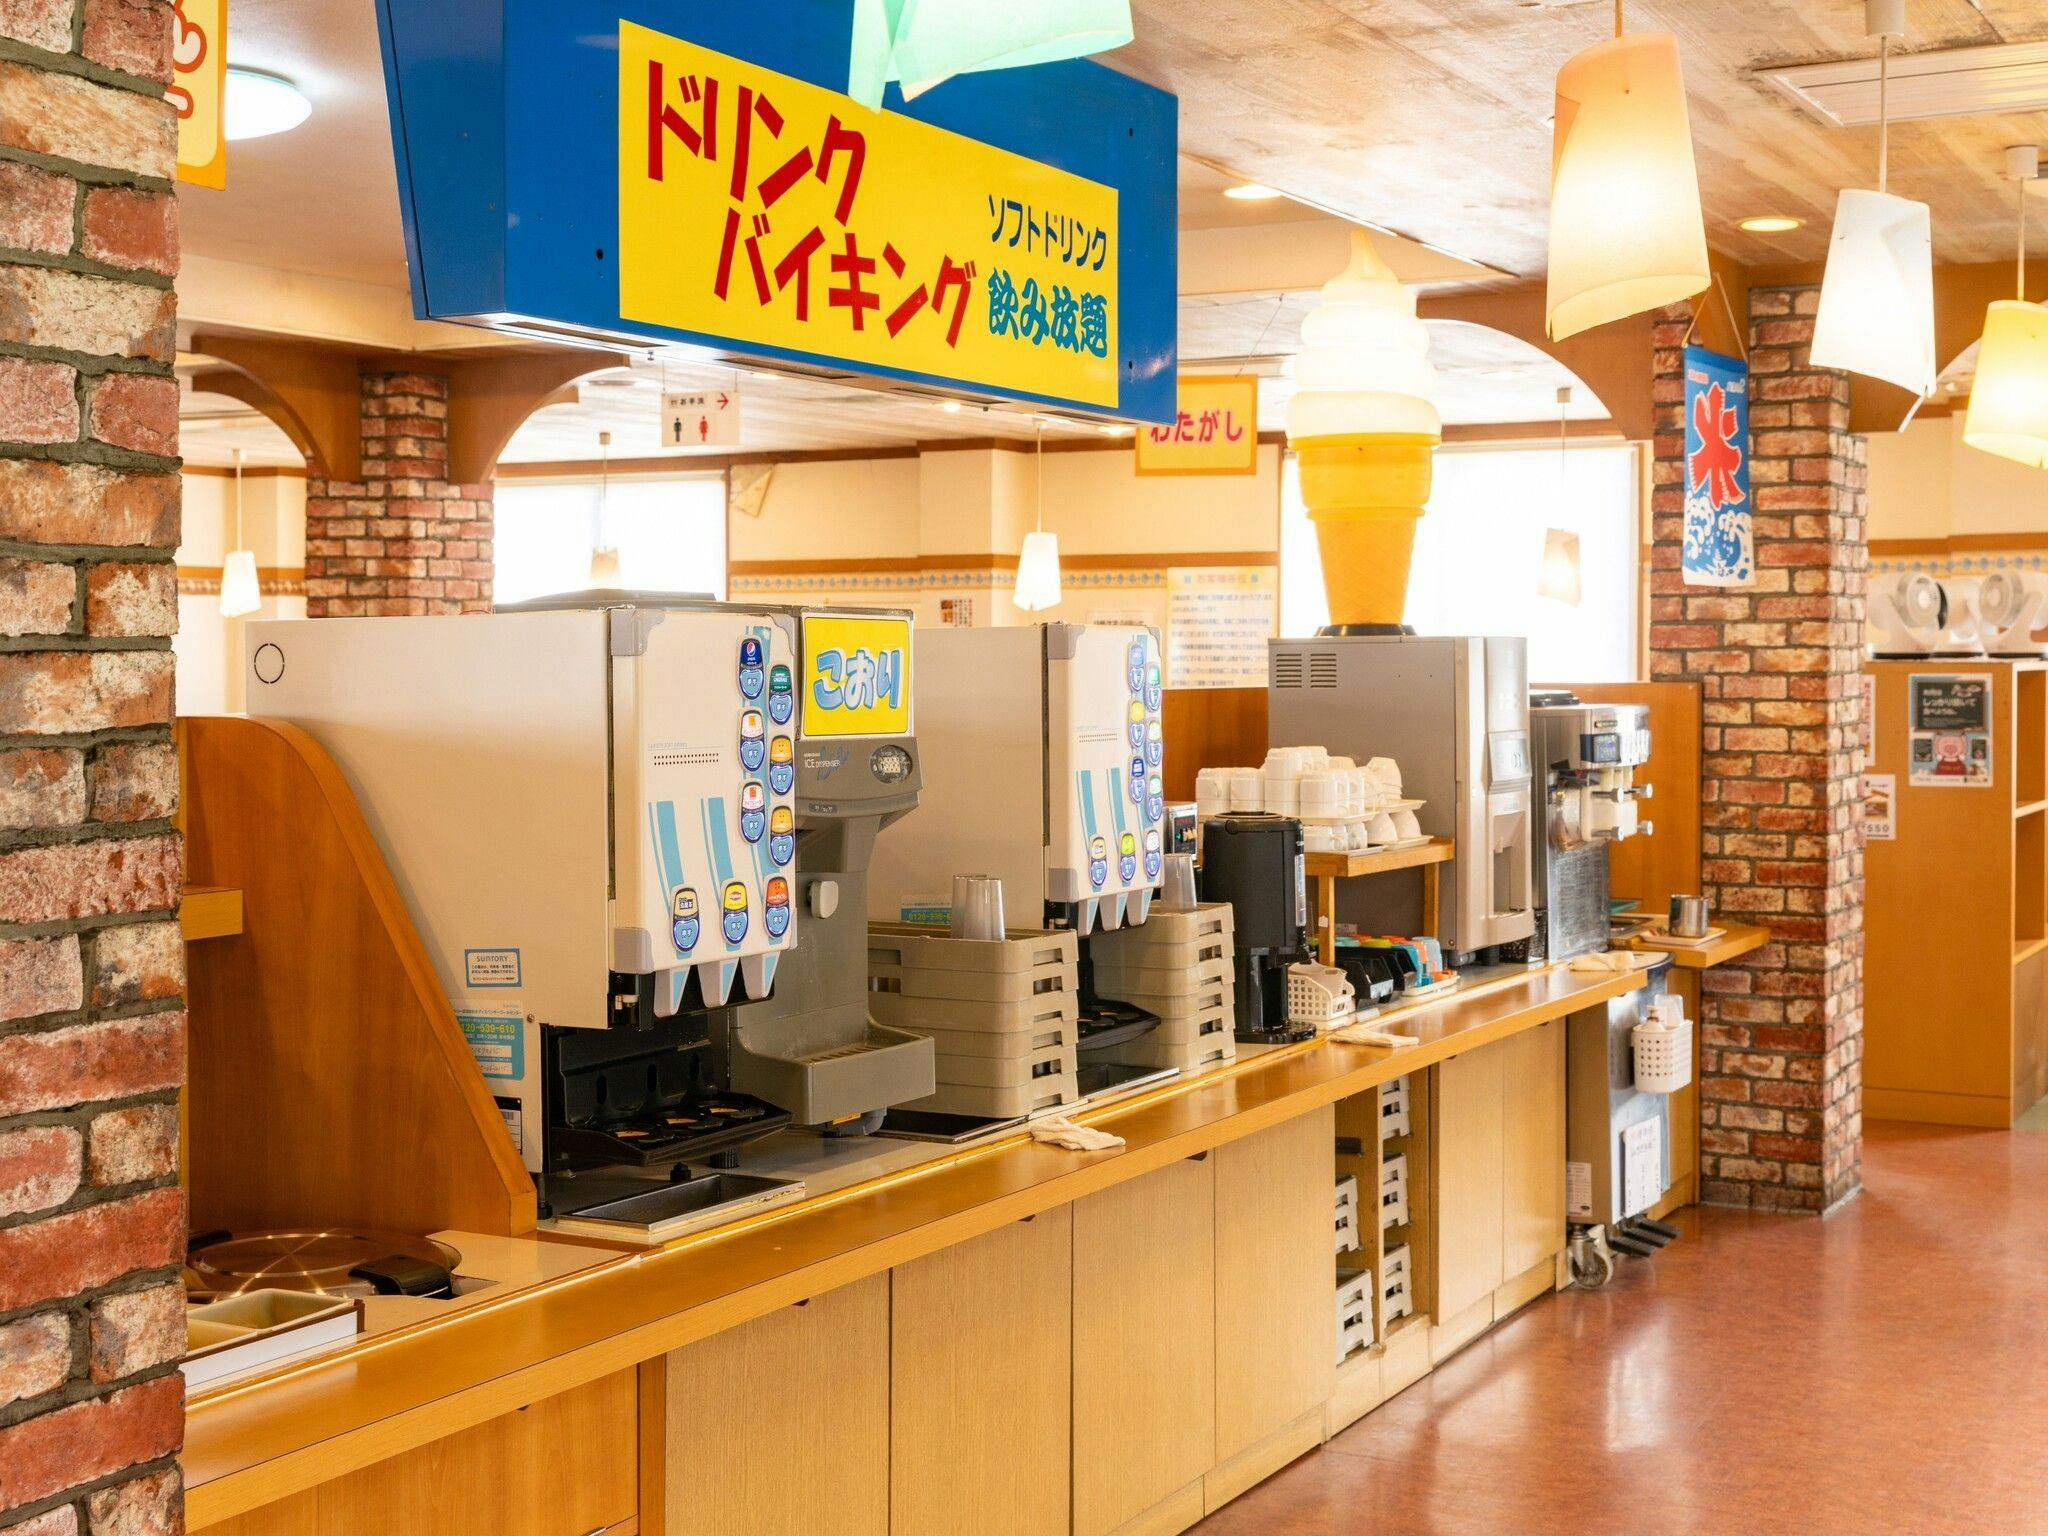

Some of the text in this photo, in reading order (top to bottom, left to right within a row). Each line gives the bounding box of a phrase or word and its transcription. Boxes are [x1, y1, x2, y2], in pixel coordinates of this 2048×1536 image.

[648, 59, 866, 226] ドリンク
[713, 206, 977, 348] バイキング
[988, 194, 1107, 271] ソフトドリンク
[988, 267, 1108, 358] 飲み放題
[813, 648, 902, 711] こおり
